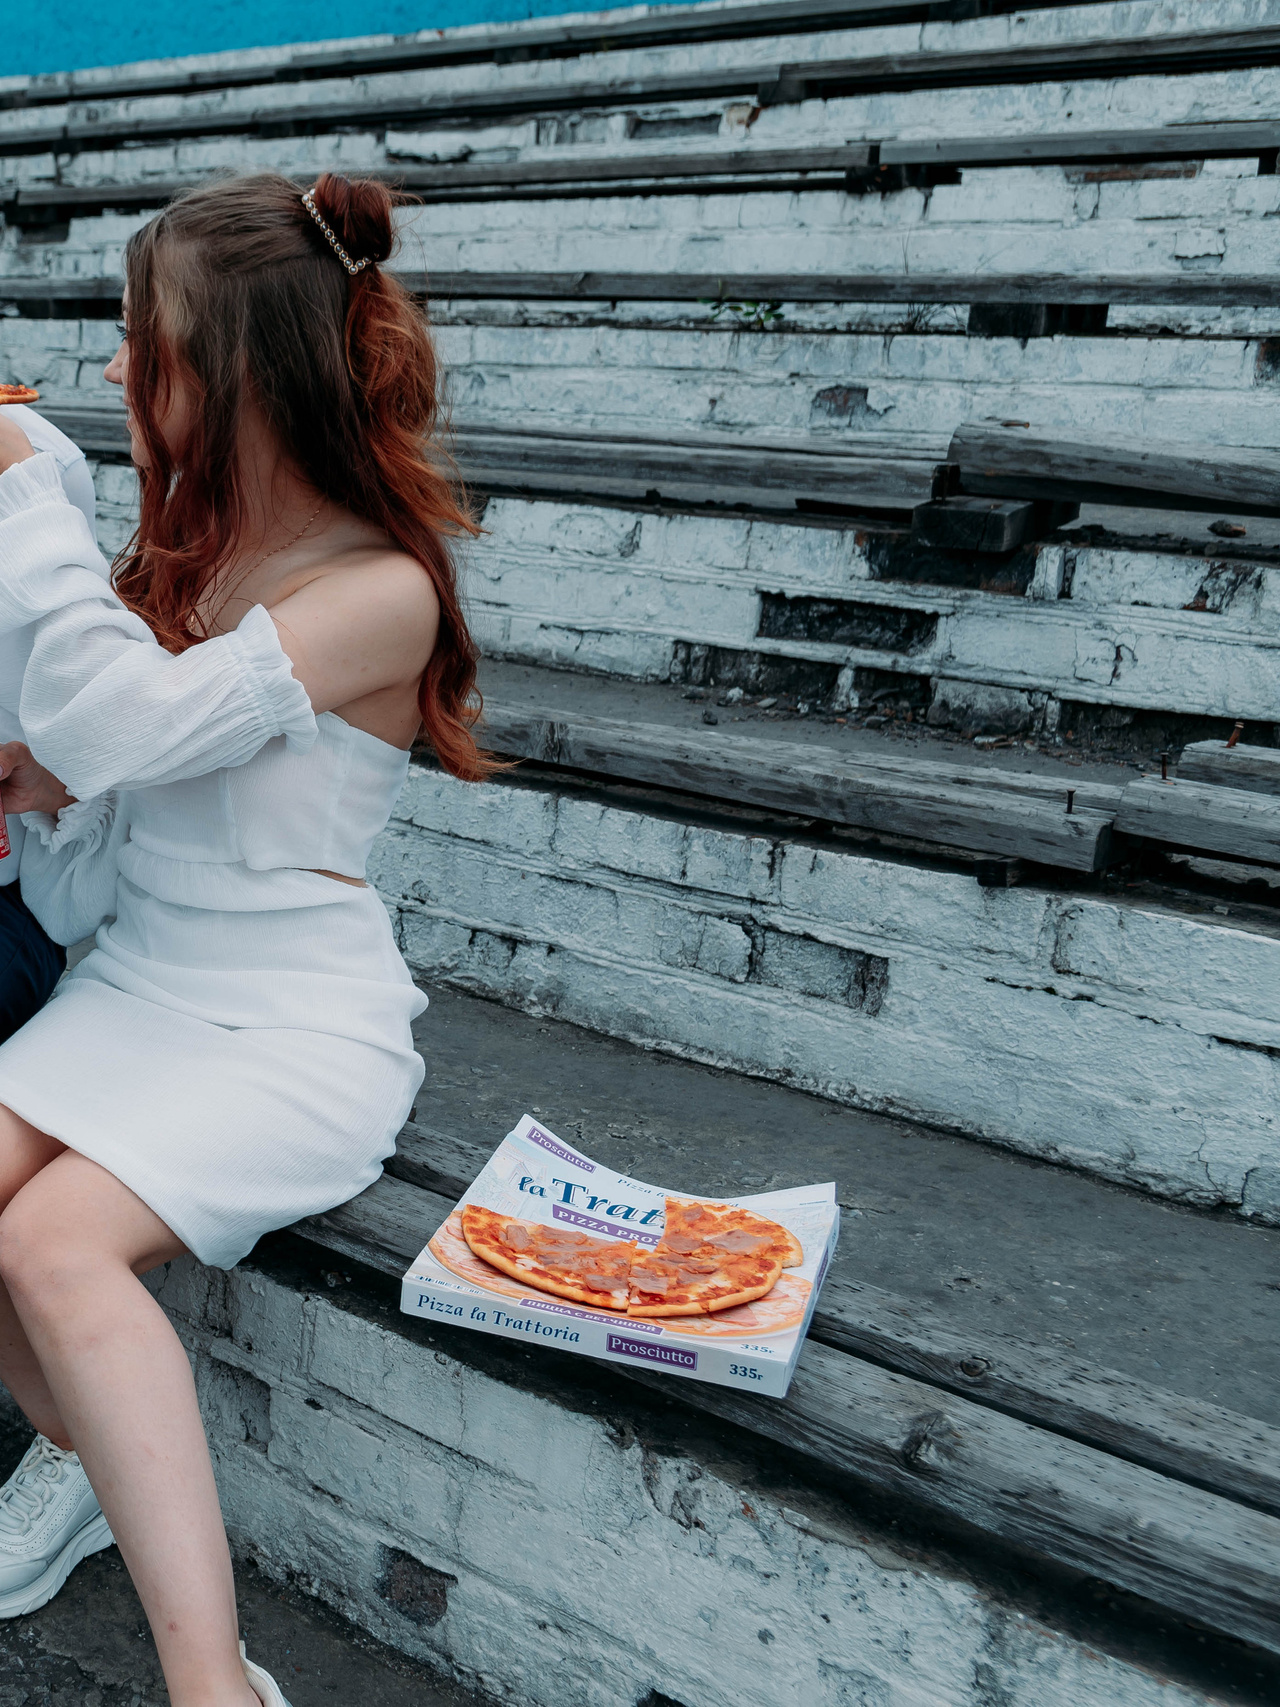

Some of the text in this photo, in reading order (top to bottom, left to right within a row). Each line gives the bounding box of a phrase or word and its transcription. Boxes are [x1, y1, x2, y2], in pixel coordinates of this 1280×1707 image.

[531, 1129, 592, 1172] Prosciutto
[518, 1176, 665, 1228] la Trat
[617, 1179, 652, 1194] Pizza
[558, 1211, 609, 1233] PIZZA
[417, 1294, 580, 1343] Pizza la Trattoria
[611, 1337, 694, 1365] Prosciutto
